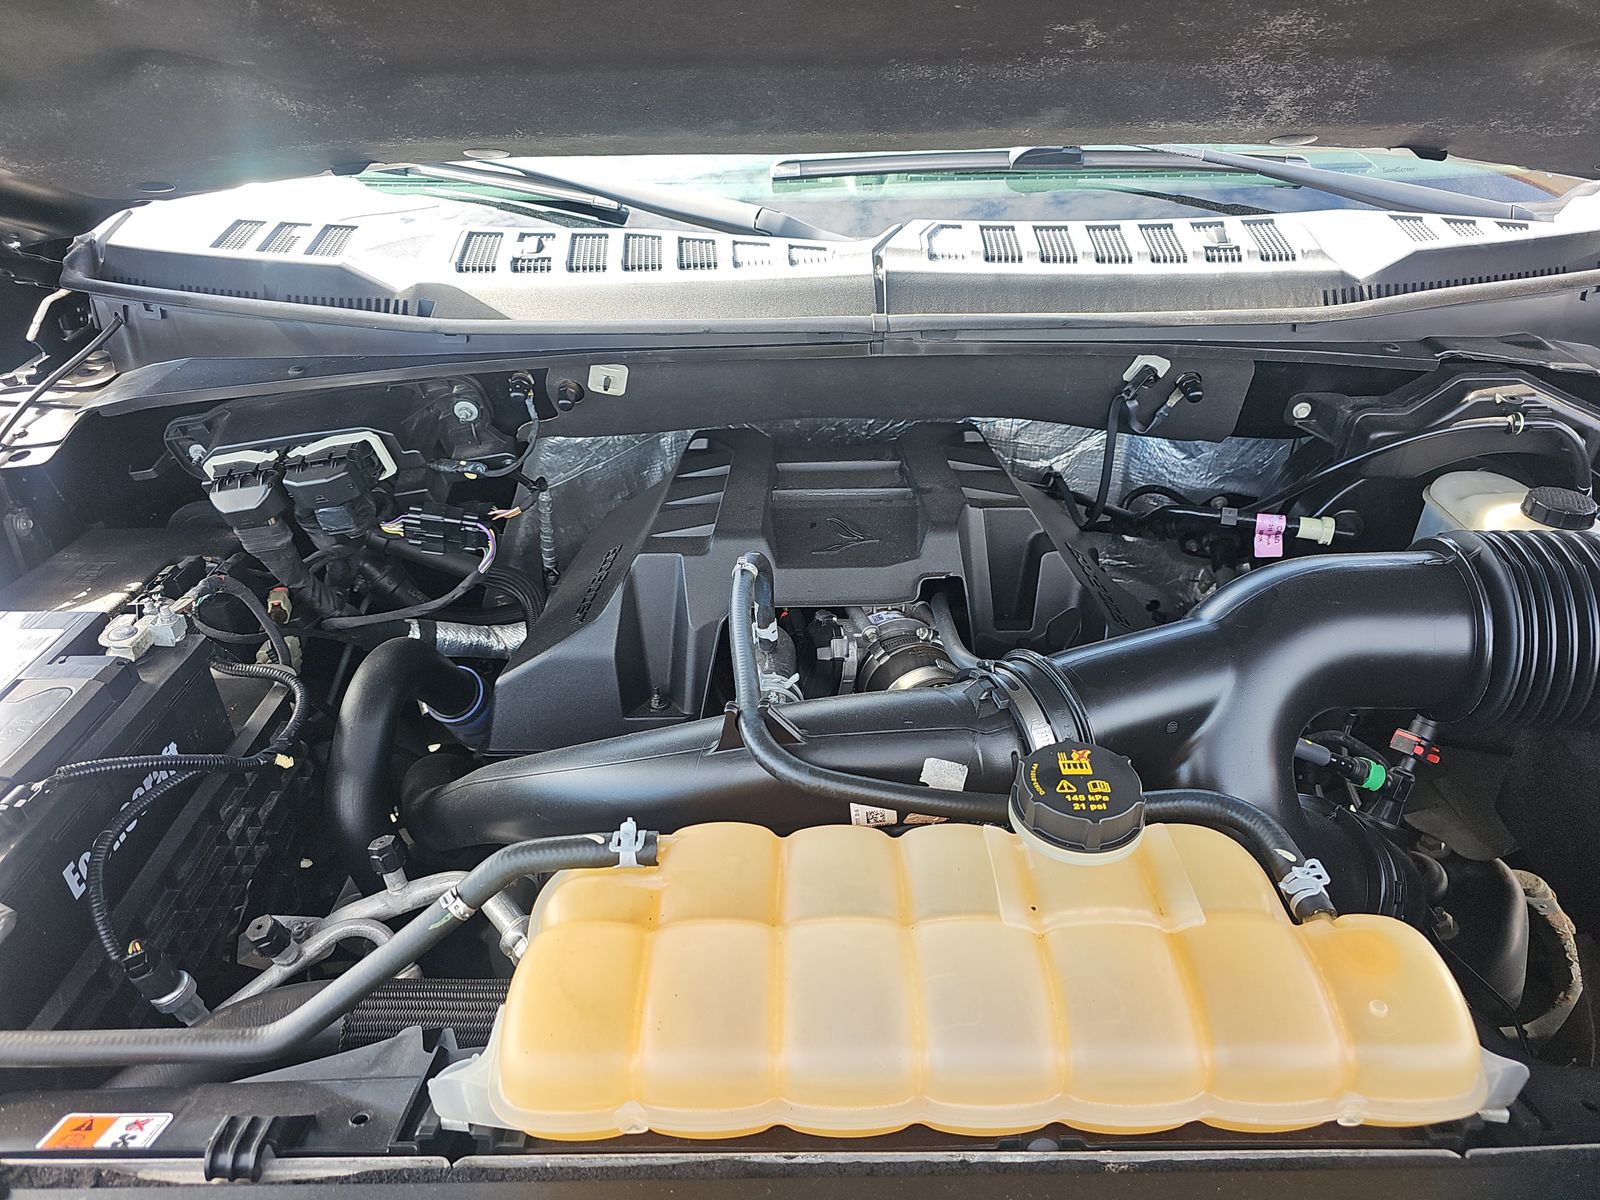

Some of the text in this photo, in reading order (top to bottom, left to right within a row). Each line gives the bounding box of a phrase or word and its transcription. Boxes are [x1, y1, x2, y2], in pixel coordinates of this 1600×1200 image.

[1065, 794, 1110, 802] 145 kPa
[1072, 802, 1107, 812] 21 psi
